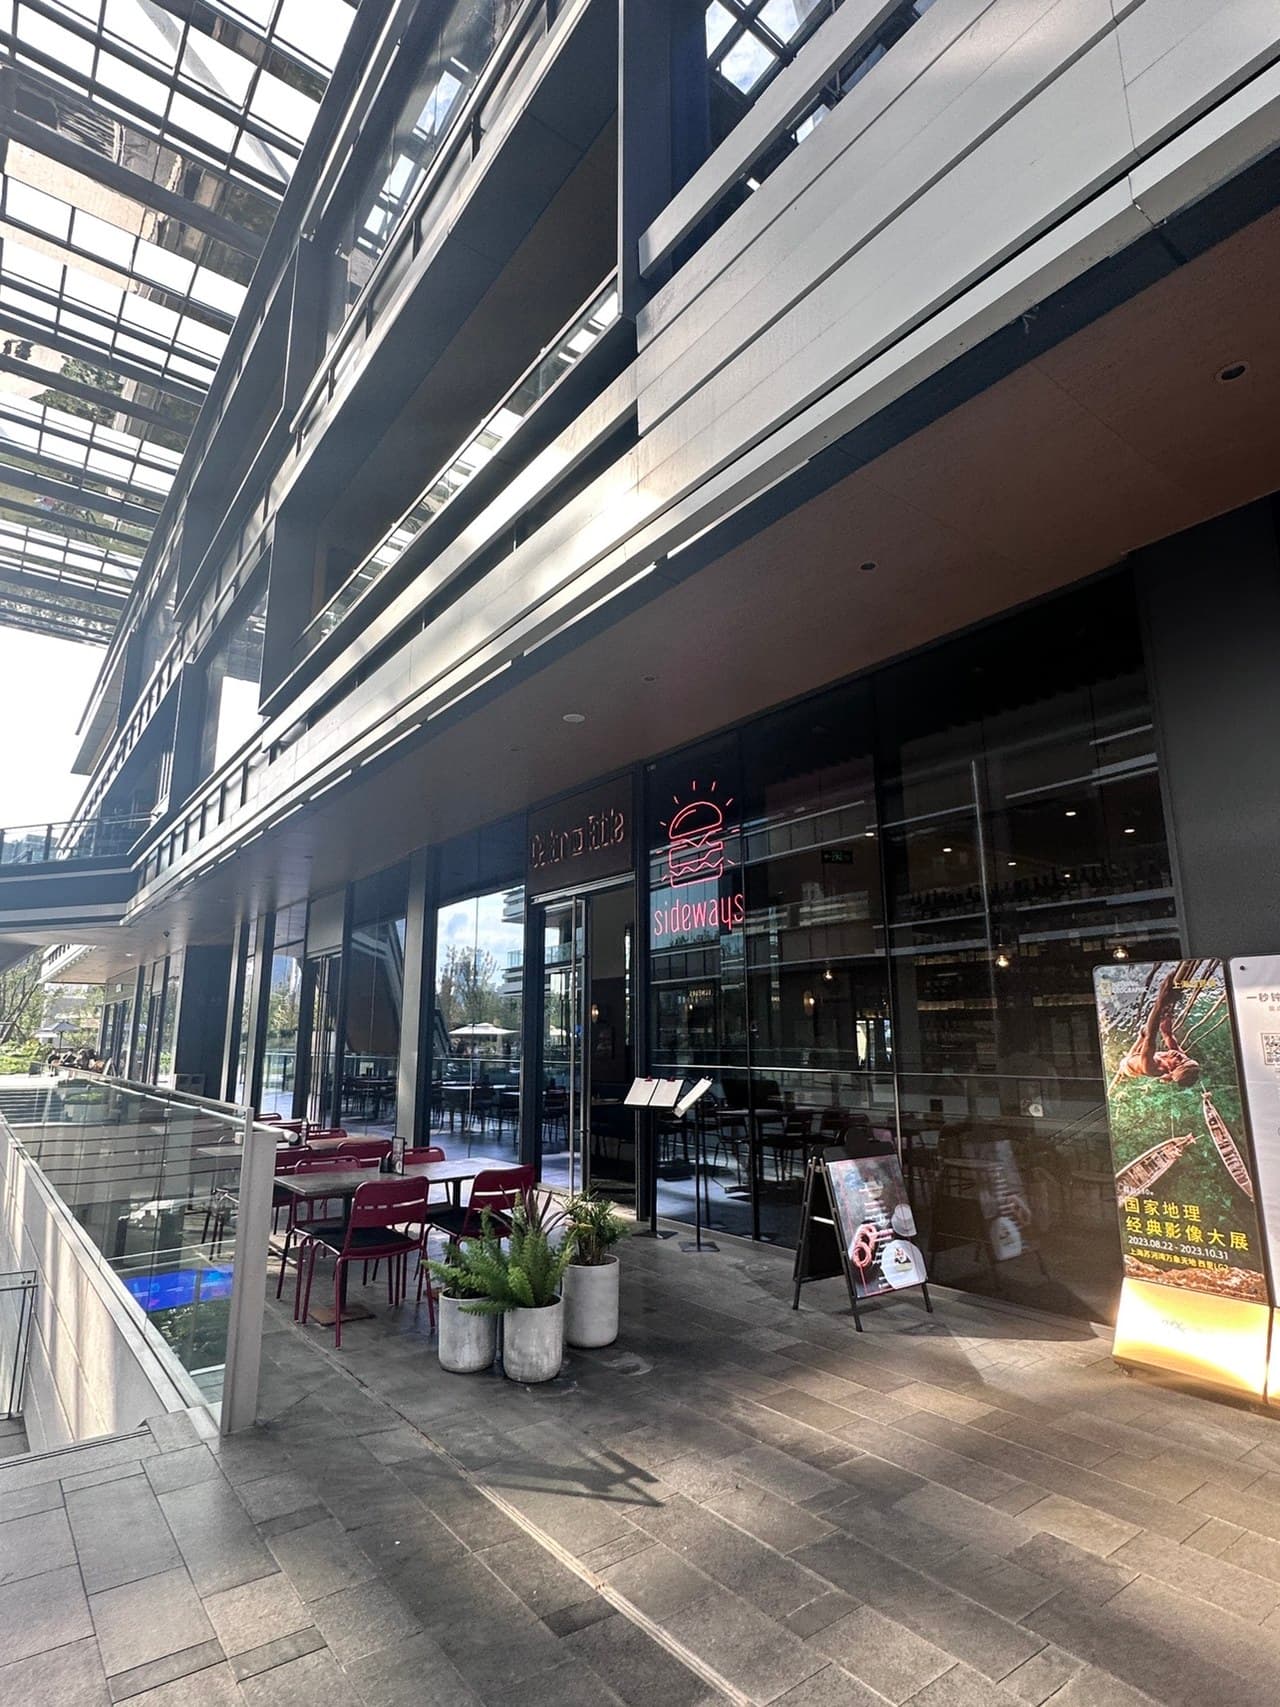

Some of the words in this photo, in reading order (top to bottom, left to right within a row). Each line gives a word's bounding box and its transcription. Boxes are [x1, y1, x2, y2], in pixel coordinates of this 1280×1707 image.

[654, 893, 744, 936] sideways
[1124, 1197, 1201, 1222] 国家地理
[1126, 1215, 1249, 1251] 经典影像大展
[1128, 1236, 1173, 1251] 2023.08.22
[1180, 1244, 1228, 1260] 2023.10.31
